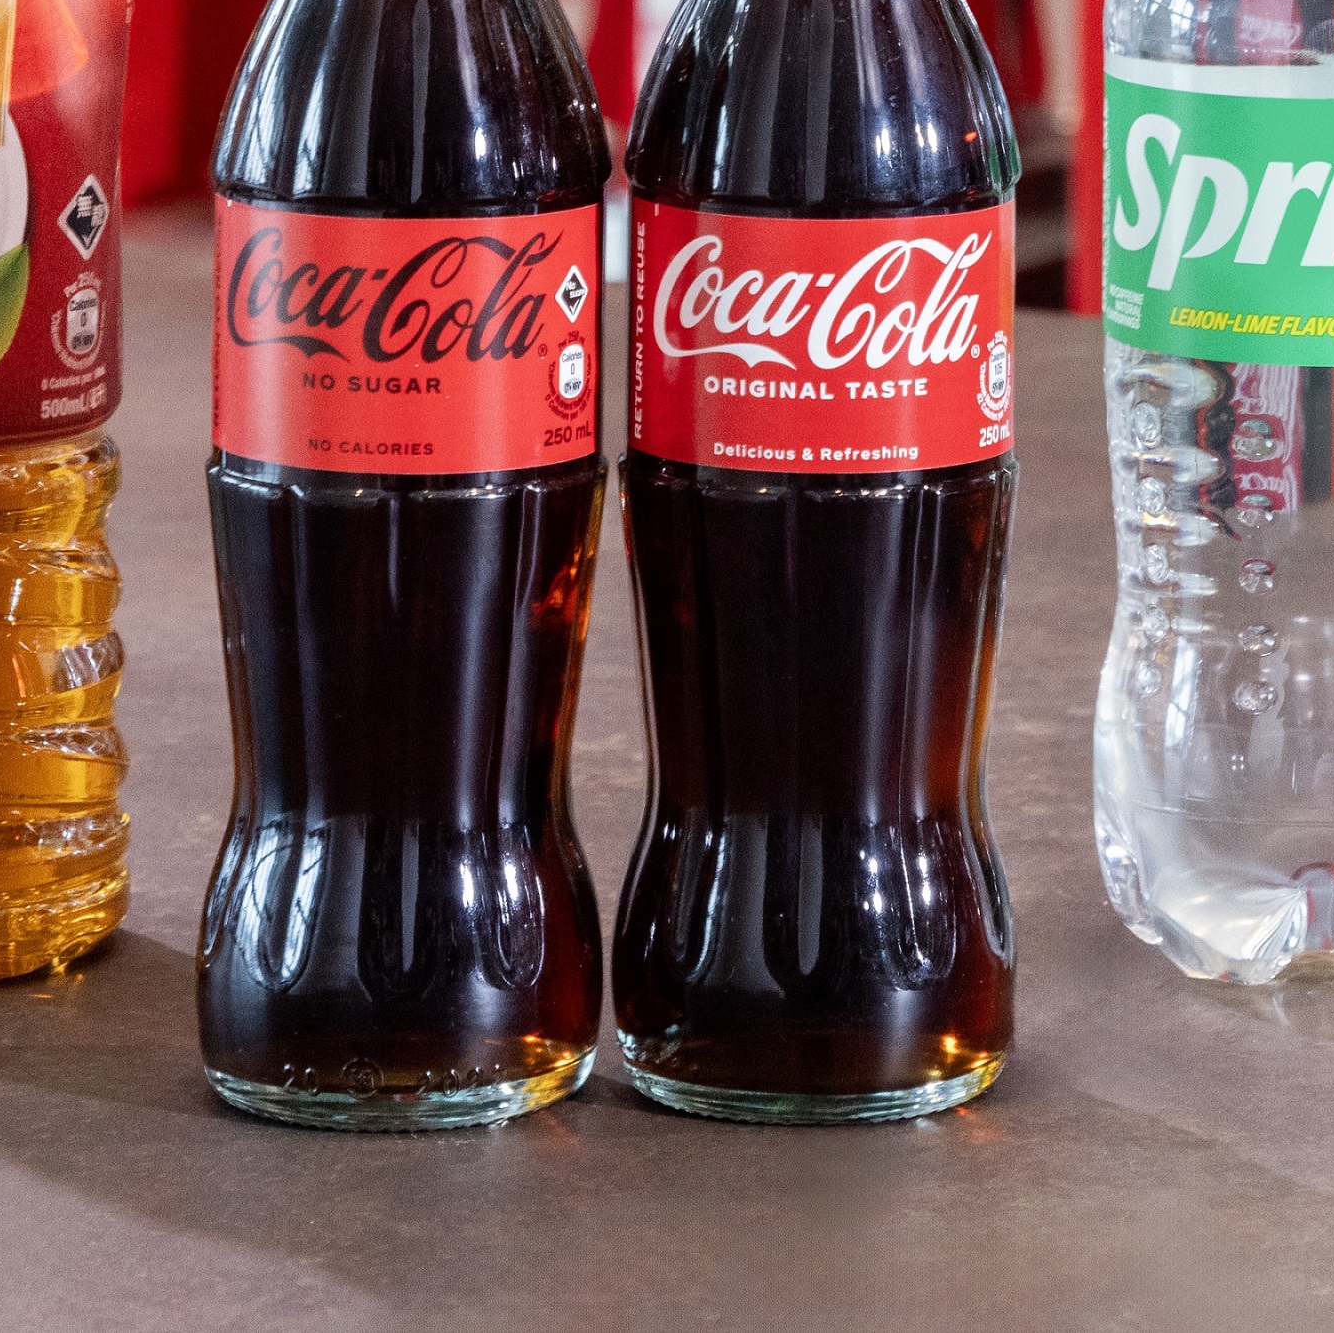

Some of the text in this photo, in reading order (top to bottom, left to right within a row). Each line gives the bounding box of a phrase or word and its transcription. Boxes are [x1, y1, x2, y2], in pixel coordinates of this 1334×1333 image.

[227, 227, 564, 364] Coca-Cola
[653, 230, 993, 370] Coca-Cola
[634, 221, 646, 441] RETURN TO REUSE
[1169, 306, 1281, 335] LEMON-LIME
[561, 351, 583, 363] Calories
[570, 363, 576, 376] 0
[302, 372, 441, 395] NO SUGAR
[704, 375, 928, 400] ORIGINAL TASTE
[544, 420, 592, 447] 250 mL
[979, 424, 999, 447] 250
[308, 438, 434, 456] NO CALORIES
[713, 442, 920, 462] Delicious & Refreshing
